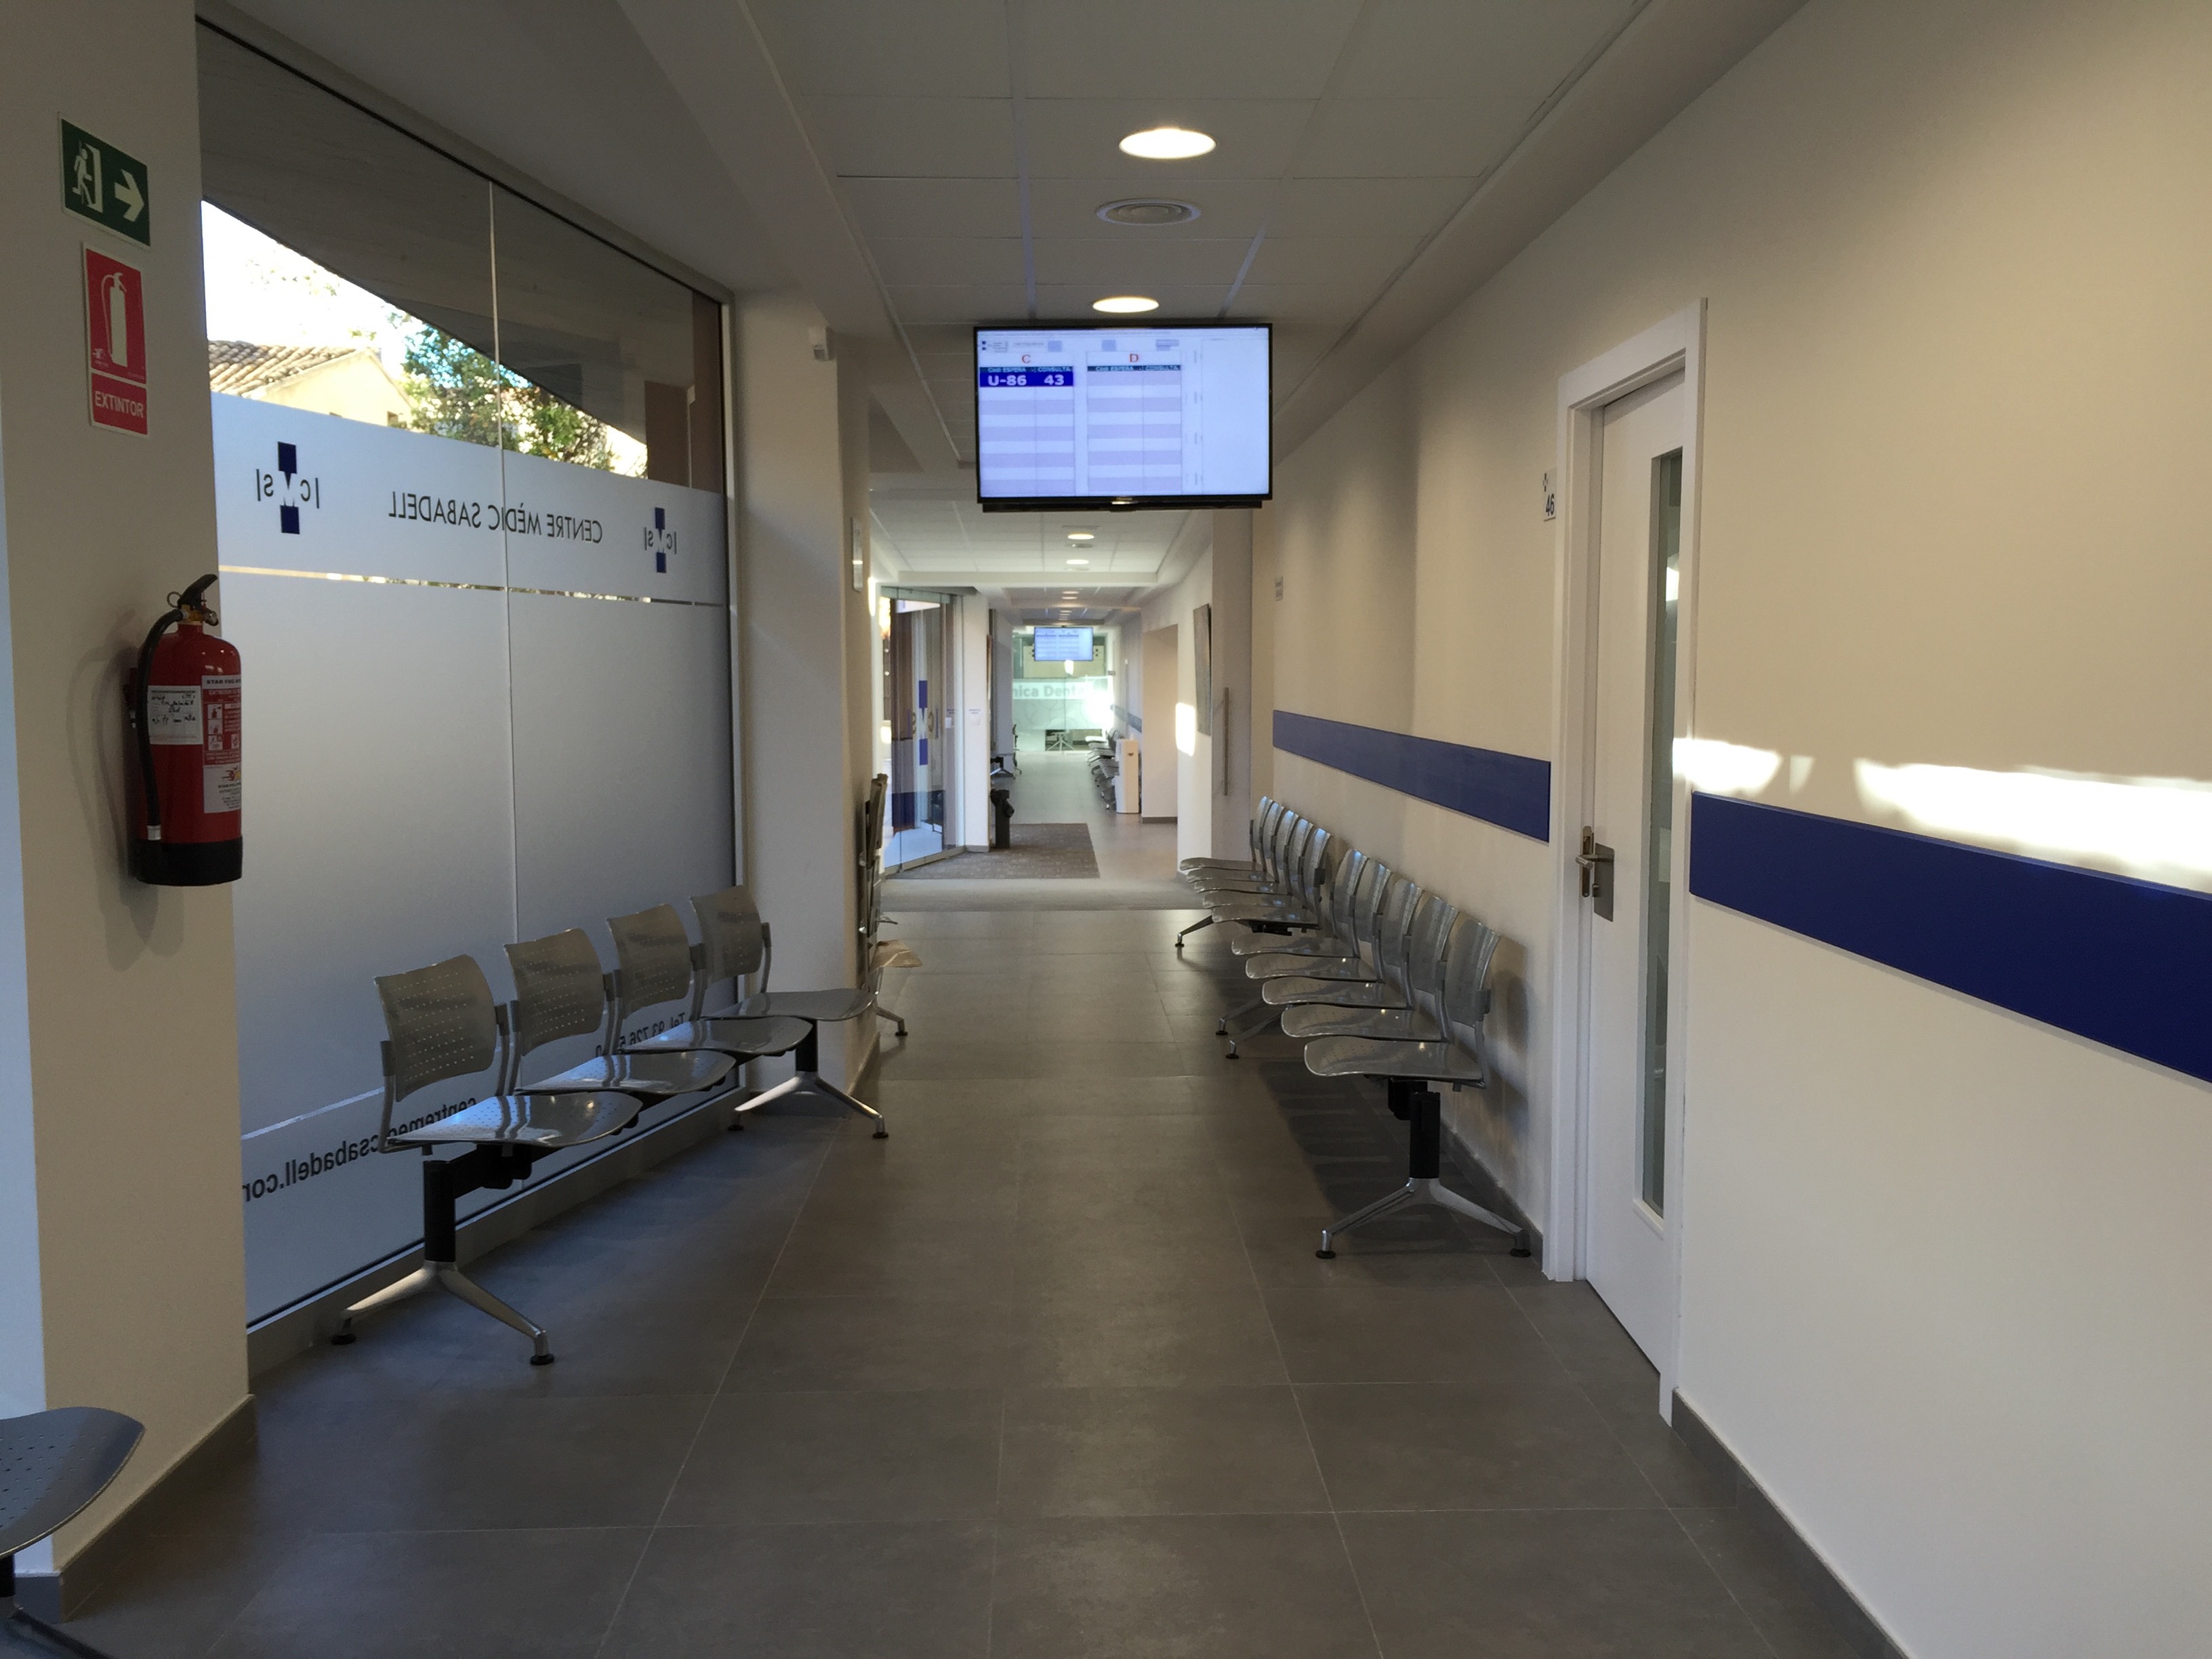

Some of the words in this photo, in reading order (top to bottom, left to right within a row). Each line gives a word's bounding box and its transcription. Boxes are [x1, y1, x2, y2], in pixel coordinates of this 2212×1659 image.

[1021, 354, 1031, 364] C
[1129, 353, 1139, 363] D
[987, 375, 1027, 386] U-86
[1044, 374, 1065, 386] 43
[95, 390, 144, 418] EXTINTOR
[1545, 493, 1555, 516] 46
